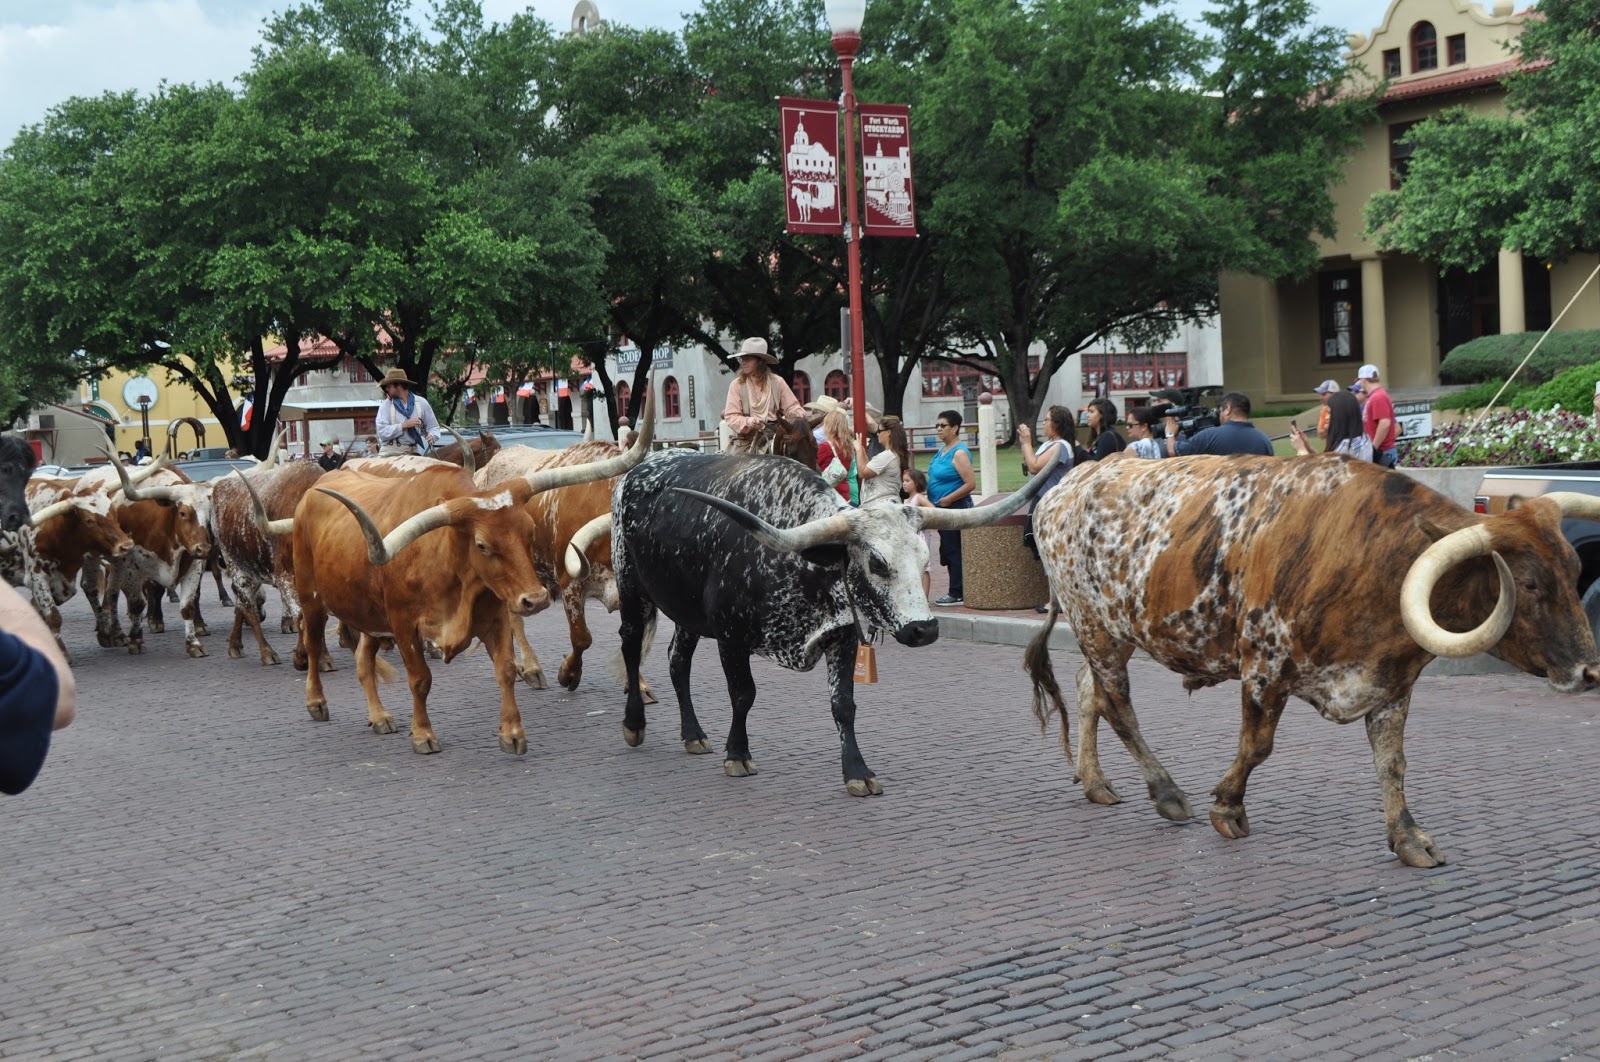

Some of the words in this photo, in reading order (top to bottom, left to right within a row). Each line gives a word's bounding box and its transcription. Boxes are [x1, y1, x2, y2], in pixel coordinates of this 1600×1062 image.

[883, 117, 899, 125] Worth
[864, 125, 904, 134] STOCKYARDS
[652, 347, 669, 360] HOP
